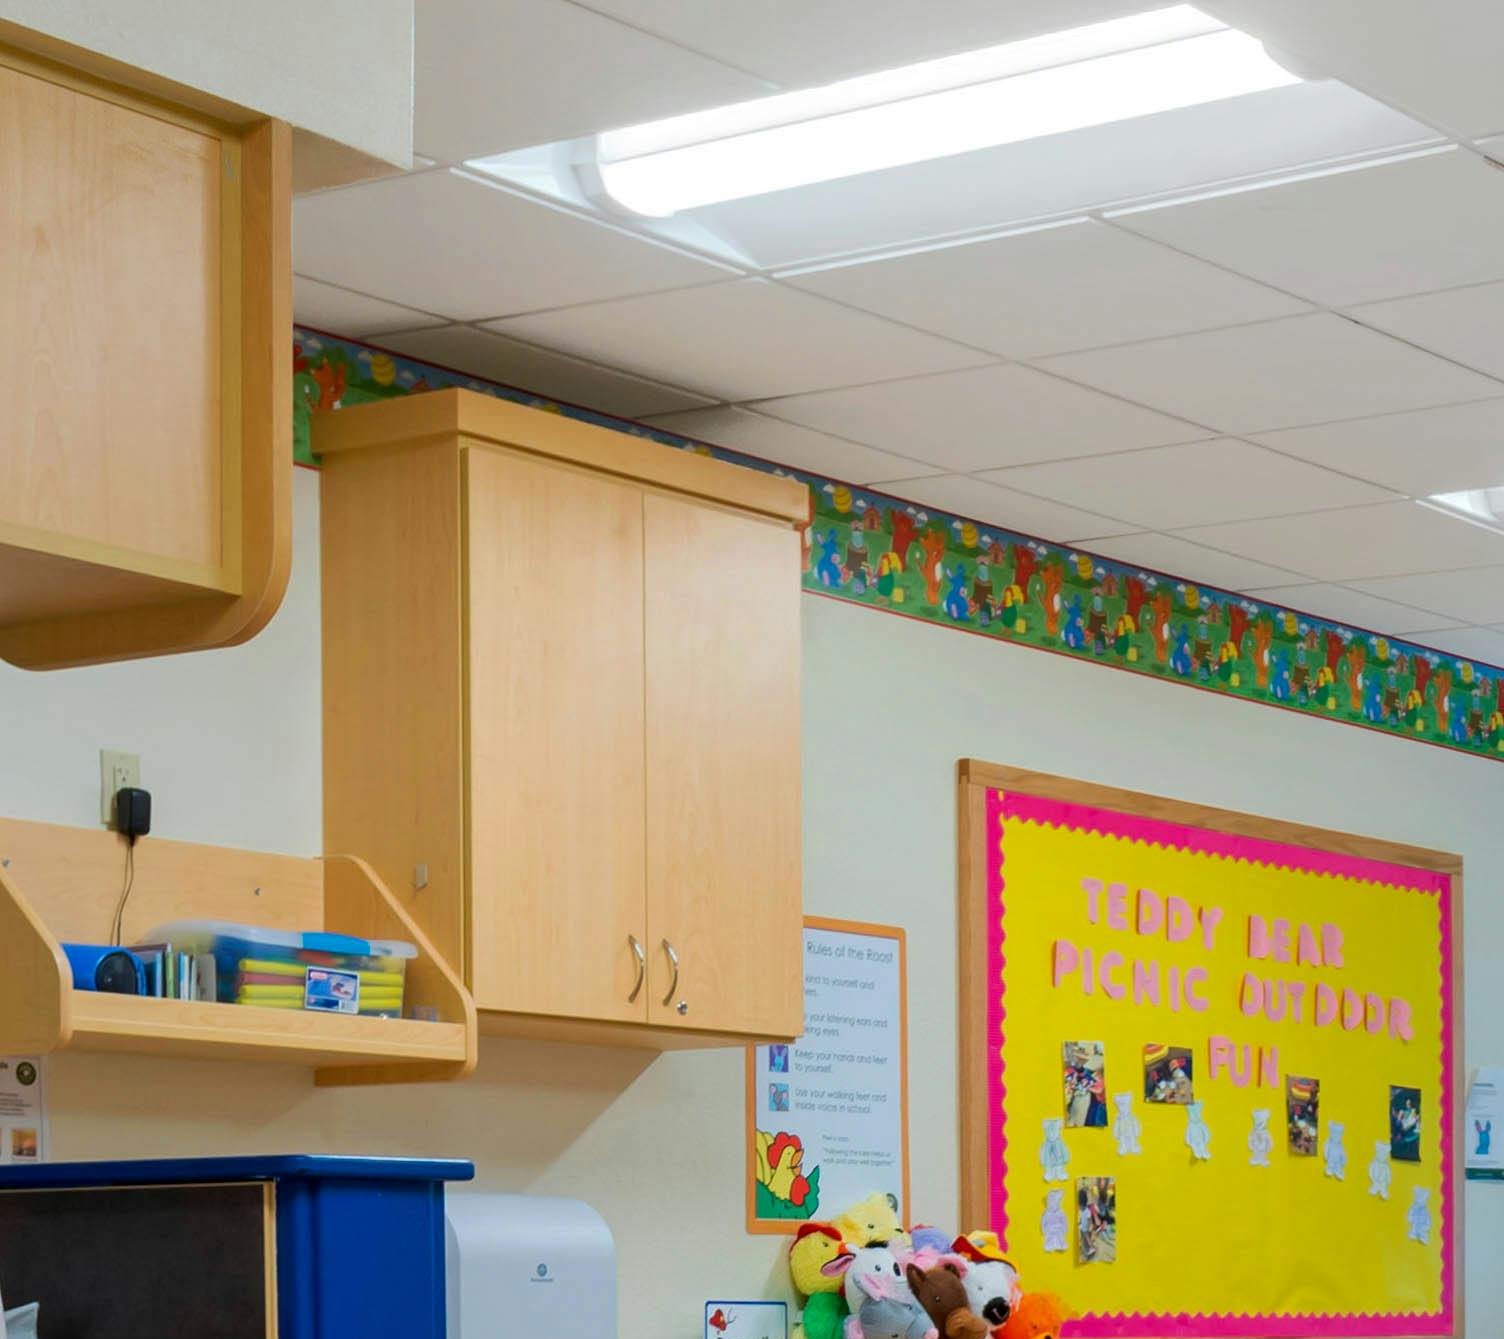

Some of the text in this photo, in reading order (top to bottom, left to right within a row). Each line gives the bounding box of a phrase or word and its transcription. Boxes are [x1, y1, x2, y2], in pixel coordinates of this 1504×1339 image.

[807, 941, 893, 963] Rules of the Roost
[1081, 877, 1344, 969] TEDDY BEAR
[1052, 939, 1210, 1013] PICNIC
[1208, 1036, 1279, 1089] FUN
